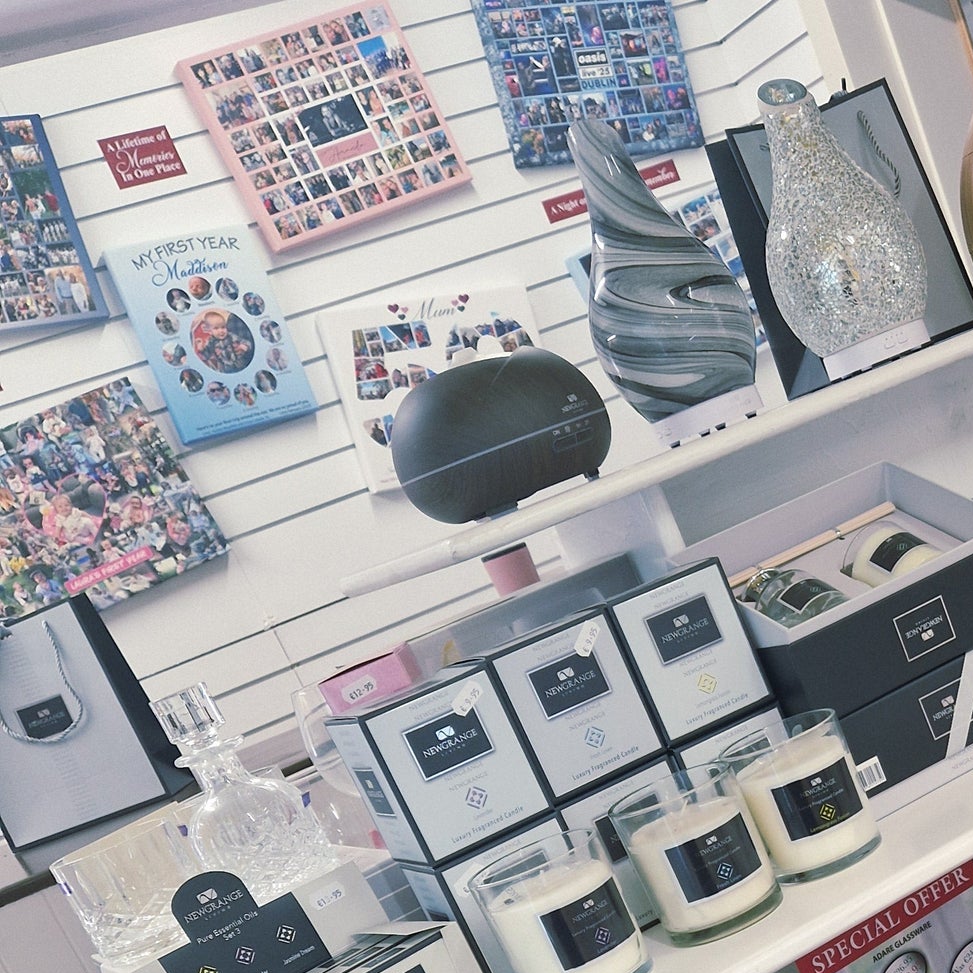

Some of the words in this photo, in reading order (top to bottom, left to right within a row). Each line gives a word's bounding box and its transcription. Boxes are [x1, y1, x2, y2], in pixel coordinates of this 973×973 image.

[578, 52, 607, 65] oasis
[581, 69, 597, 78] live
[581, 78, 617, 89] DUBLIN
[106, 143, 115, 153] A
[115, 135, 155, 151] Lifetime
[155, 130, 167, 142] of
[116, 149, 175, 175] Memories
[120, 170, 133, 183] In
[133, 166, 155, 180] One
[155, 161, 181, 175] Place
[556, 197, 579, 213] Night
[131, 249, 155, 271] MY
[154, 237, 195, 260] FIRST
[196, 236, 240, 250] YEAR
[151, 257, 229, 287] Maddison
[414, 298, 456, 320] Mum
[71, 573, 100, 590] LAURA'S
[101, 560, 124, 577] FIRST
[126, 550, 148, 566] YEAR
[661, 617, 709, 644] NEWGRANGE
[905, 615, 944, 640] NEWGRANGE
[545, 670, 597, 699] NEWGRANGE
[686, 711, 704, 726] Luxury
[703, 700, 732, 720] Fragranced
[731, 692, 749, 707] Candle
[423, 727, 478, 759] NEWGRANGE
[572, 766, 591, 782] Luxury
[590, 752, 621, 775] Fragranced
[620, 745, 640, 759] Candle
[451, 830, 472, 844] Luxury
[471, 814, 504, 838] Fragranced
[503, 805, 524, 819] Candle
[184, 889, 244, 924] NEWGRANGE
[903, 867, 971, 917] OFFER
[197, 931, 213, 944] Pure
[213, 917, 244, 938] Essential
[243, 910, 259, 922] Oils
[222, 930, 234, 941] Set
[234, 928, 241, 936] 3
[872, 943, 895, 963] ADARE
[893, 919, 933, 951] GLASSWARE
